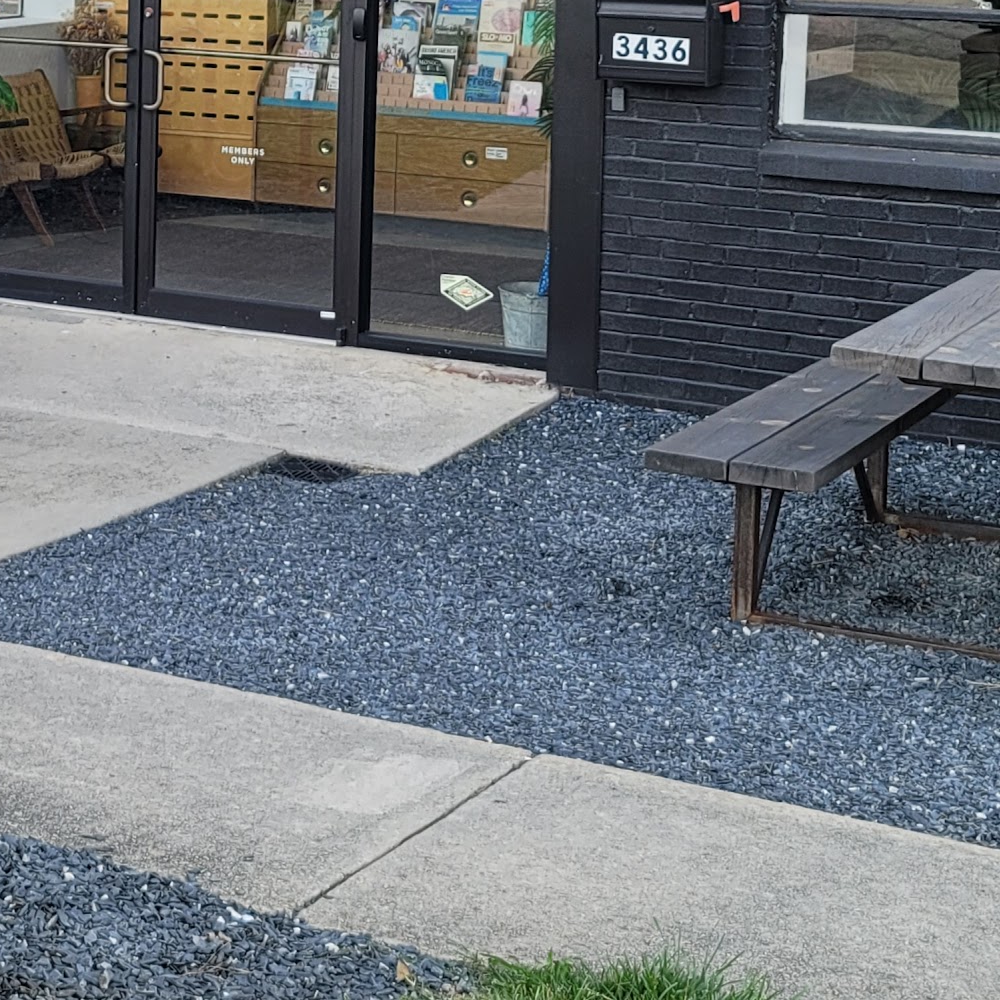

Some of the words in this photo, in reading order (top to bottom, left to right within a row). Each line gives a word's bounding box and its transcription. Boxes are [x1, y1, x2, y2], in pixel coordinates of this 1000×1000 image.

[616, 35, 687, 63] 3436
[221, 145, 265, 156] MEMBERS
[230, 156, 256, 165] ONLY
